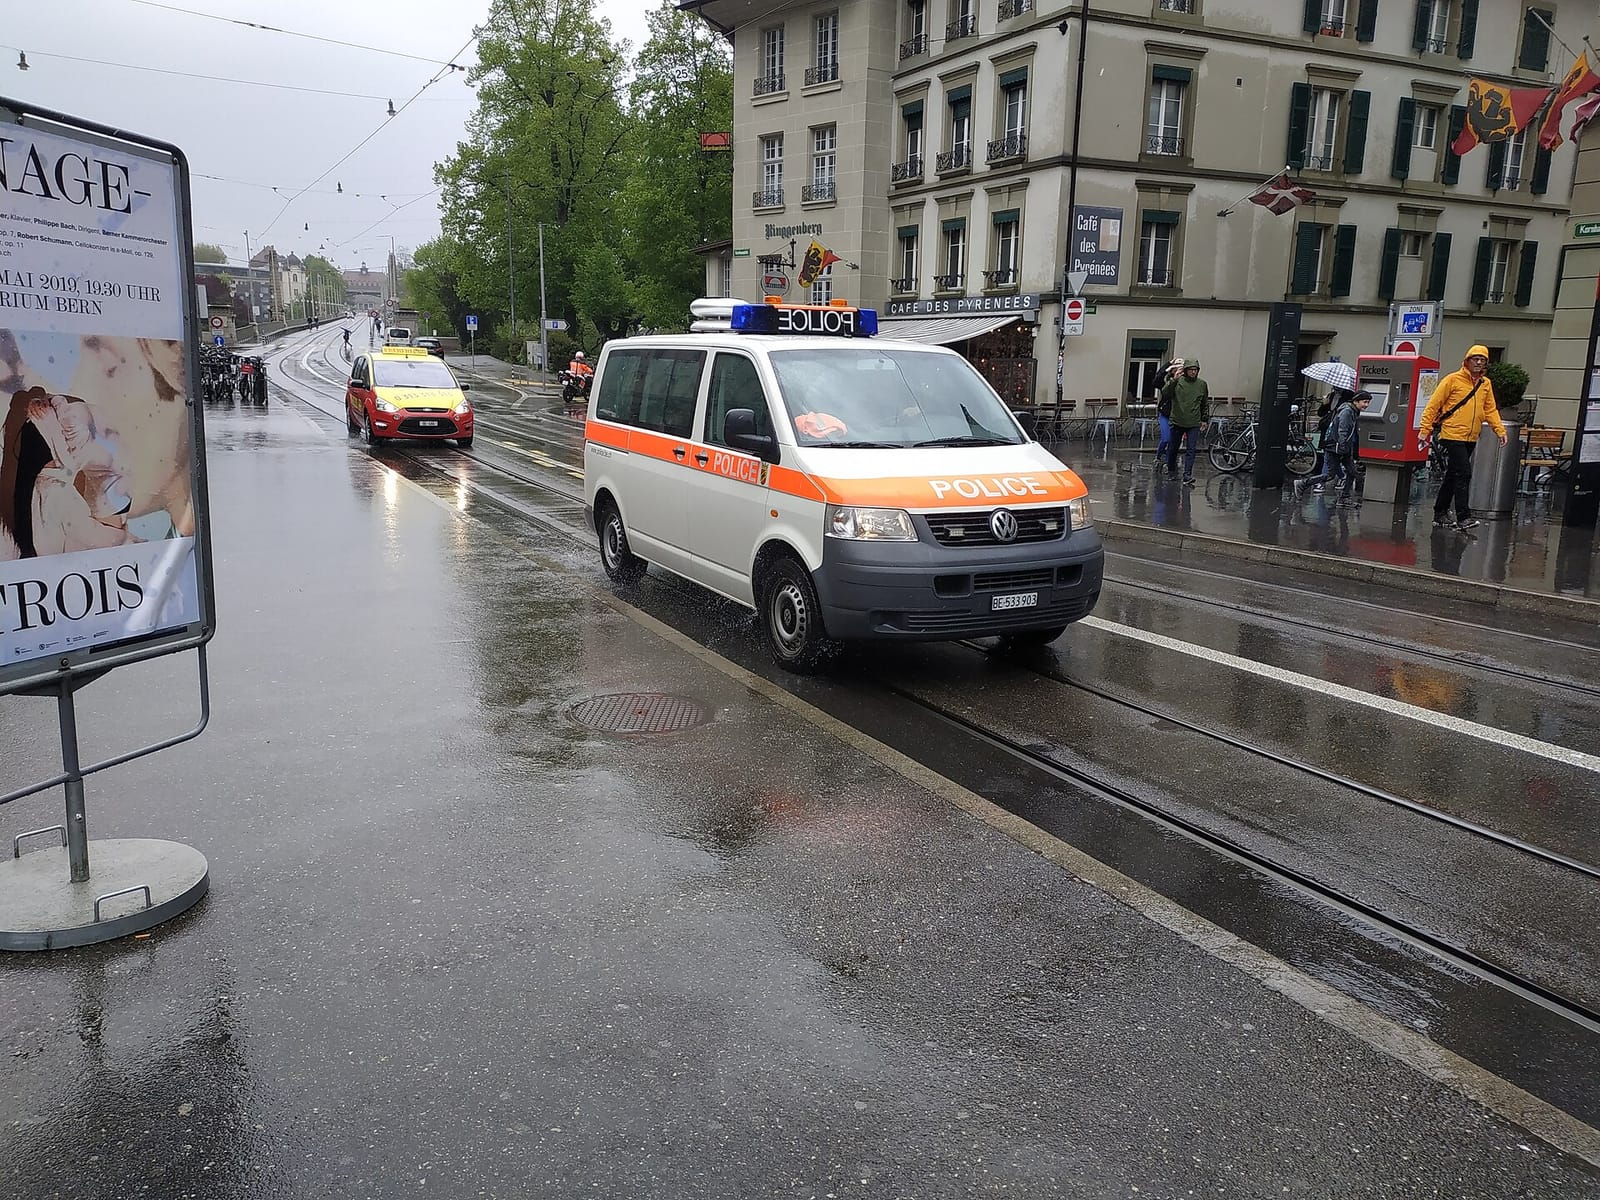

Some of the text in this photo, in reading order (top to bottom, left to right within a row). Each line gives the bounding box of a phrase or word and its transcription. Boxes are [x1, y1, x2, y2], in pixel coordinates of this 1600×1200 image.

[675, 69, 688, 79] 25
[33, 217, 59, 228] Philippe
[60, 222, 77, 231] Bach,
[765, 221, 823, 240] Ringgenberg
[1077, 214, 1098, 231] Café
[17, 231, 38, 241] Robert
[1080, 237, 1096, 253] des
[39, 273, 80, 297] 2019,
[85, 279, 121, 298] 19.30
[126, 284, 160, 302] UHR
[55, 296, 103, 315] BERN
[891, 295, 1031, 313] CAFE DES PYRENEES
[1361, 364, 1389, 375] Tickets
[713, 452, 760, 484] POLICE
[928, 476, 1047, 499] POLICE
[0, 562, 144, 635] ROIS
